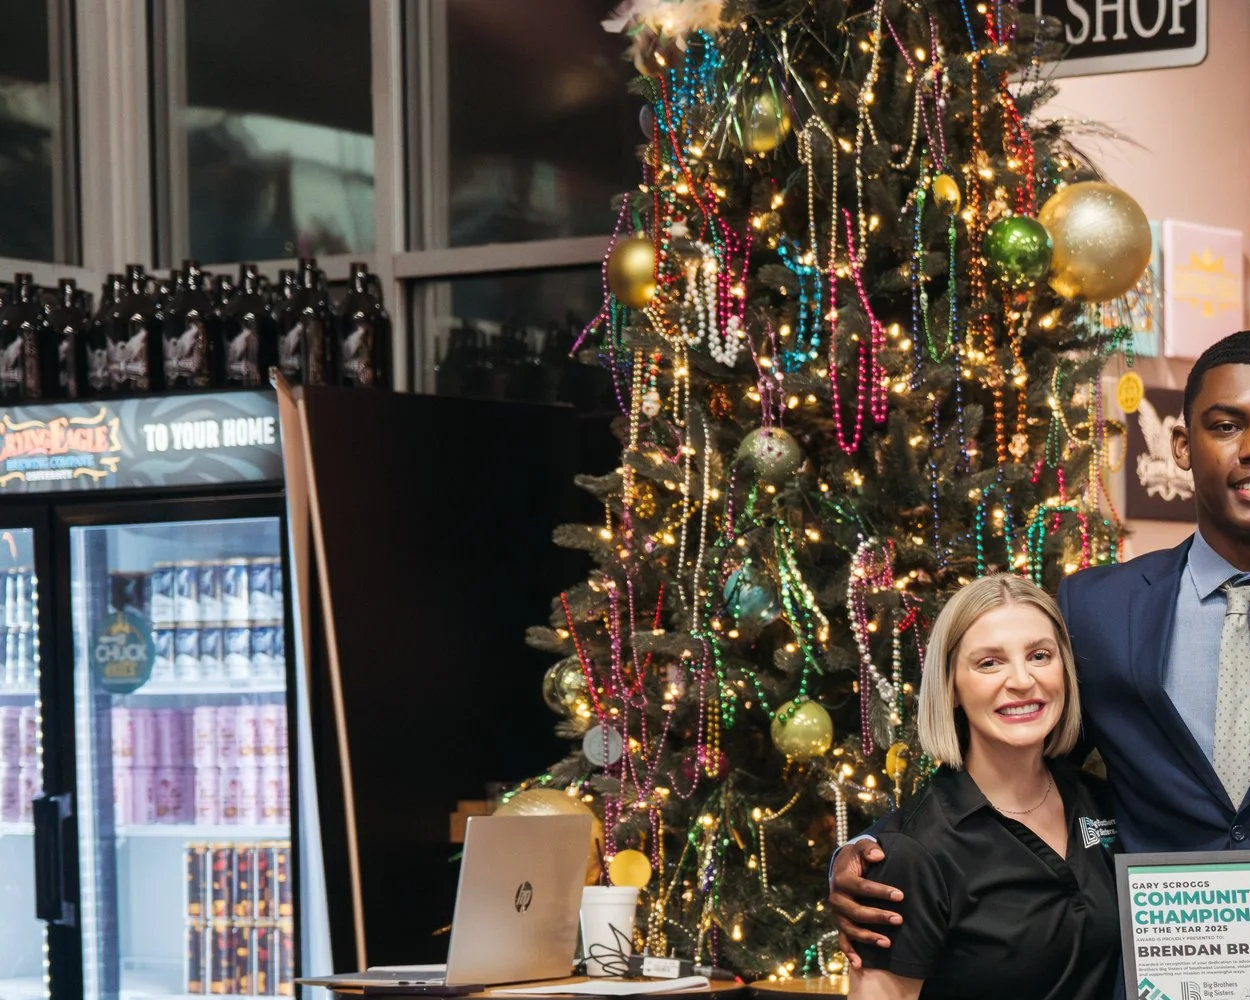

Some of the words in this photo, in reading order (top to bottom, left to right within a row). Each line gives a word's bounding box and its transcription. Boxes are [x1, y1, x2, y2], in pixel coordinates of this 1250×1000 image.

[1064, 0, 1194, 45] SHOP
[143, 422, 169, 452] TO
[170, 420, 220, 450] YOUR
[222, 416, 276, 447] HOME
[1132, 882, 1159, 890] GARY
[1162, 881, 1210, 889] SCROGGS
[1135, 908, 1250, 925] CHAMPION
[1138, 944, 1221, 957] BRENDAN
[1203, 982, 1213, 990] Big
